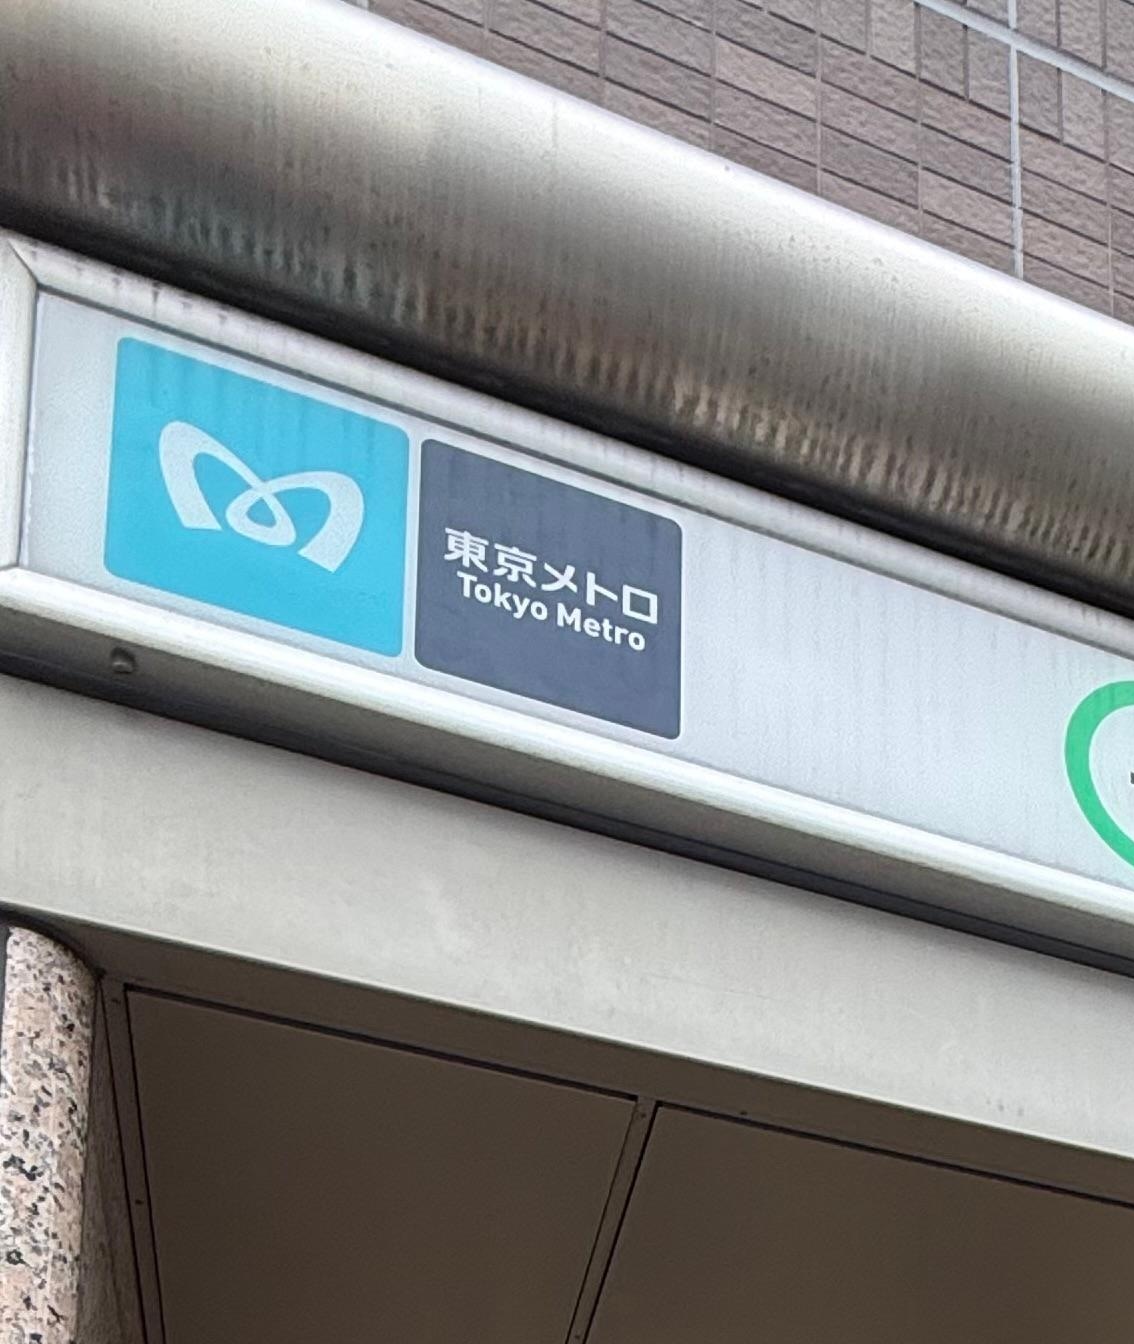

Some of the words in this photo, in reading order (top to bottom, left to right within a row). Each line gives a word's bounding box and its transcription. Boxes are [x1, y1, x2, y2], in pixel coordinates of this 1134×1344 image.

[444, 527, 658, 625] 東京メトロ
[456, 571, 548, 625] Tokyo
[557, 603, 646, 651] Metro
